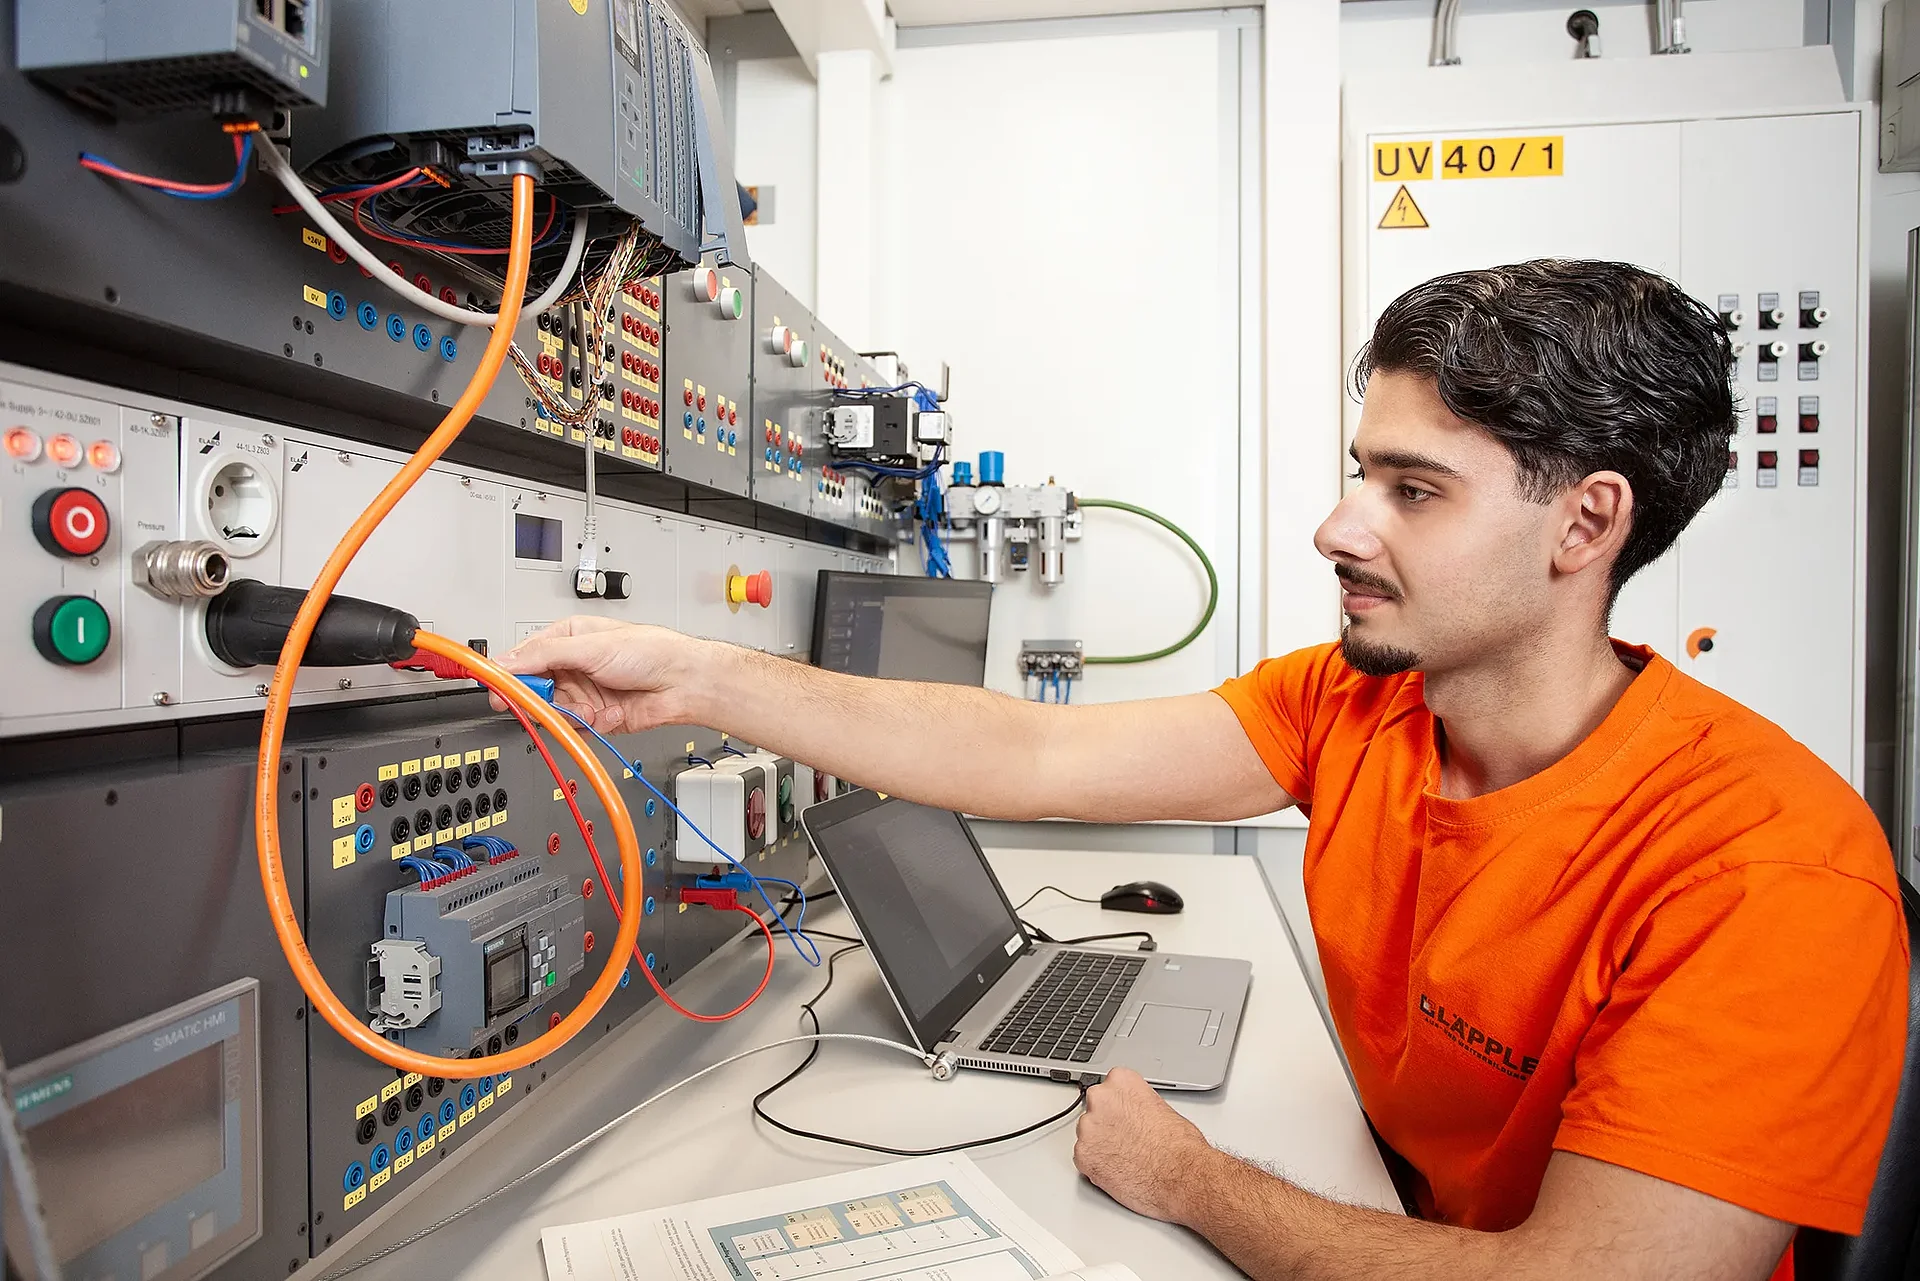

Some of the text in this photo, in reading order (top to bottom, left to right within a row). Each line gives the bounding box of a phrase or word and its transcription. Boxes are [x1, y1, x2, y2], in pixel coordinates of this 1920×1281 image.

[1377, 142, 1553, 177] UV 40/1
[307, 235, 322, 247] +24V
[137, 520, 166, 532] Pressure
[153, 1010, 226, 1051] SIMATIC HMI
